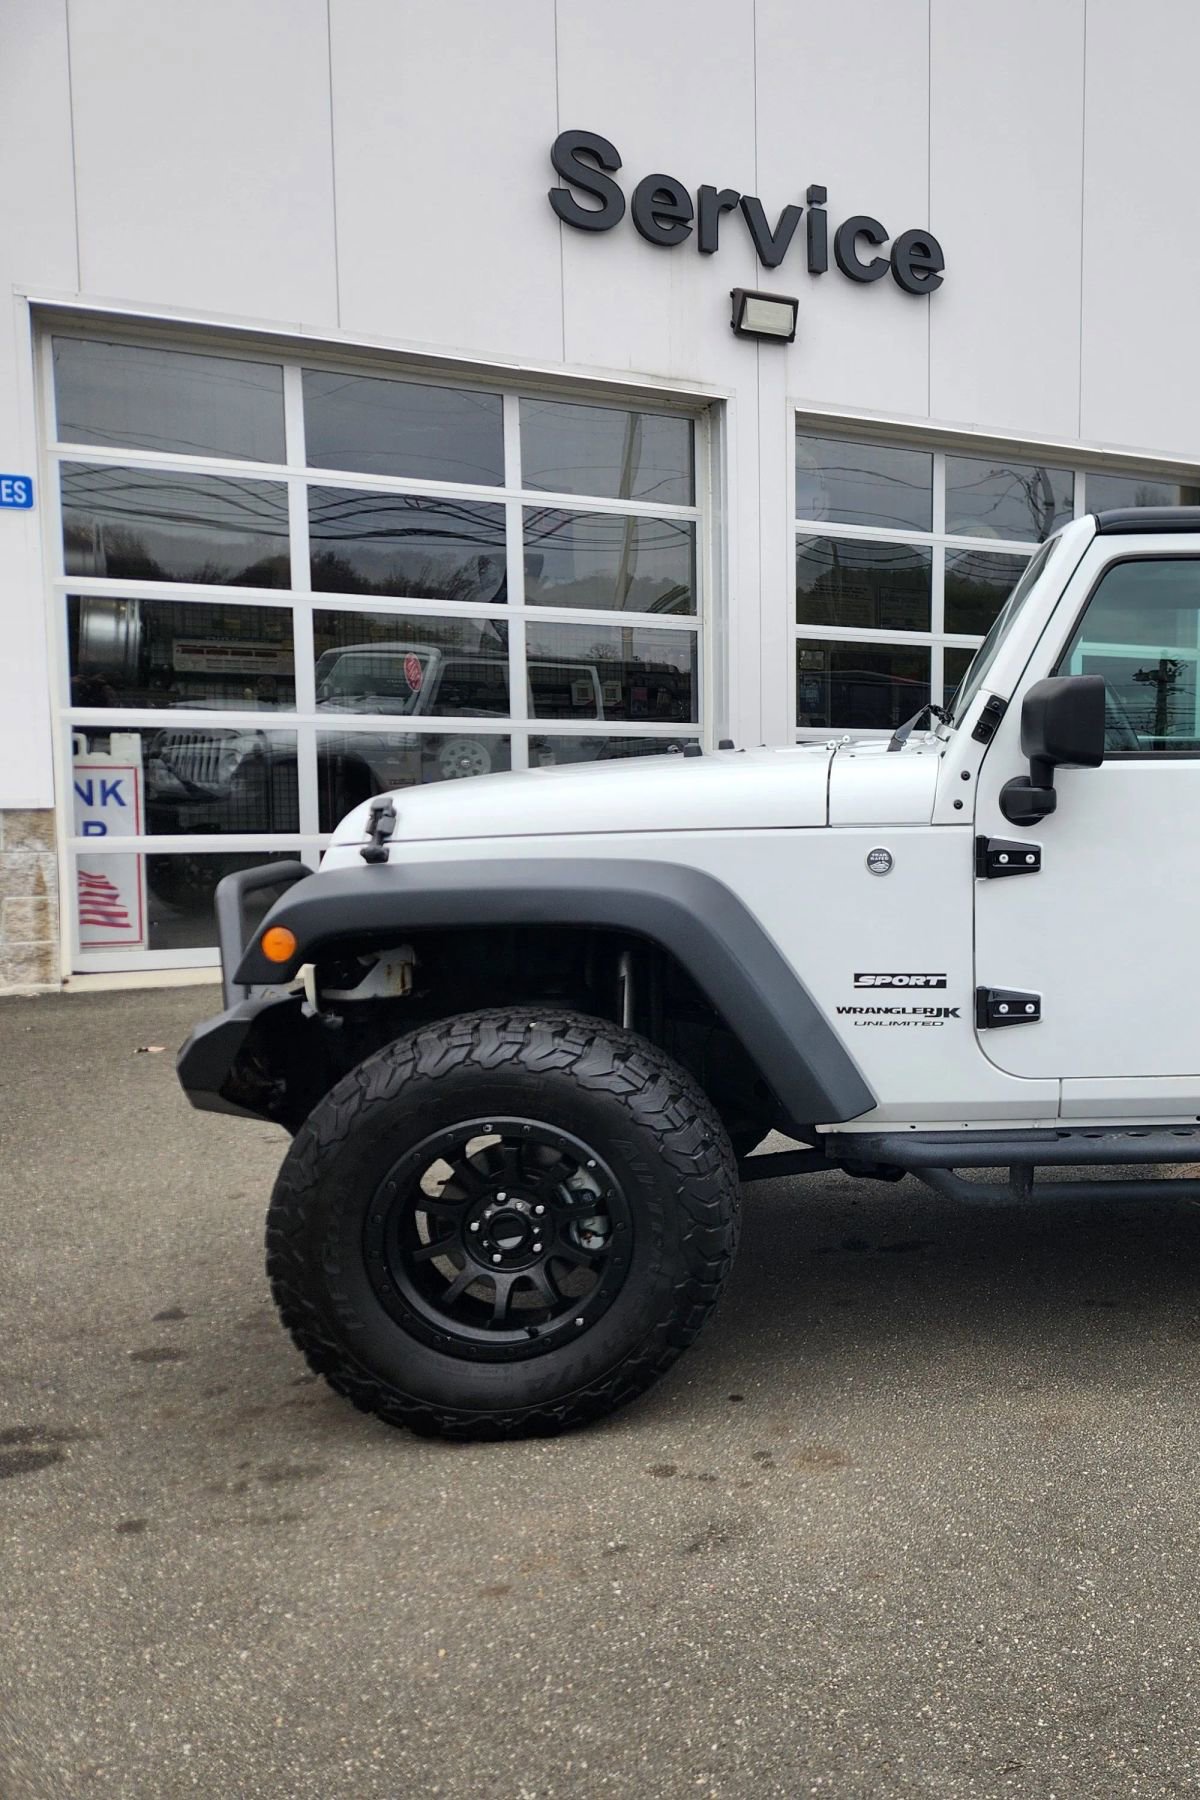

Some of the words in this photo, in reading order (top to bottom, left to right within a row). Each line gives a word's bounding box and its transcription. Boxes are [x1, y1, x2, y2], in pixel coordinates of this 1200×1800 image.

[548, 130, 945, 295] Service
[1, 479, 27, 504] ES
[854, 975, 946, 986] SPORT
